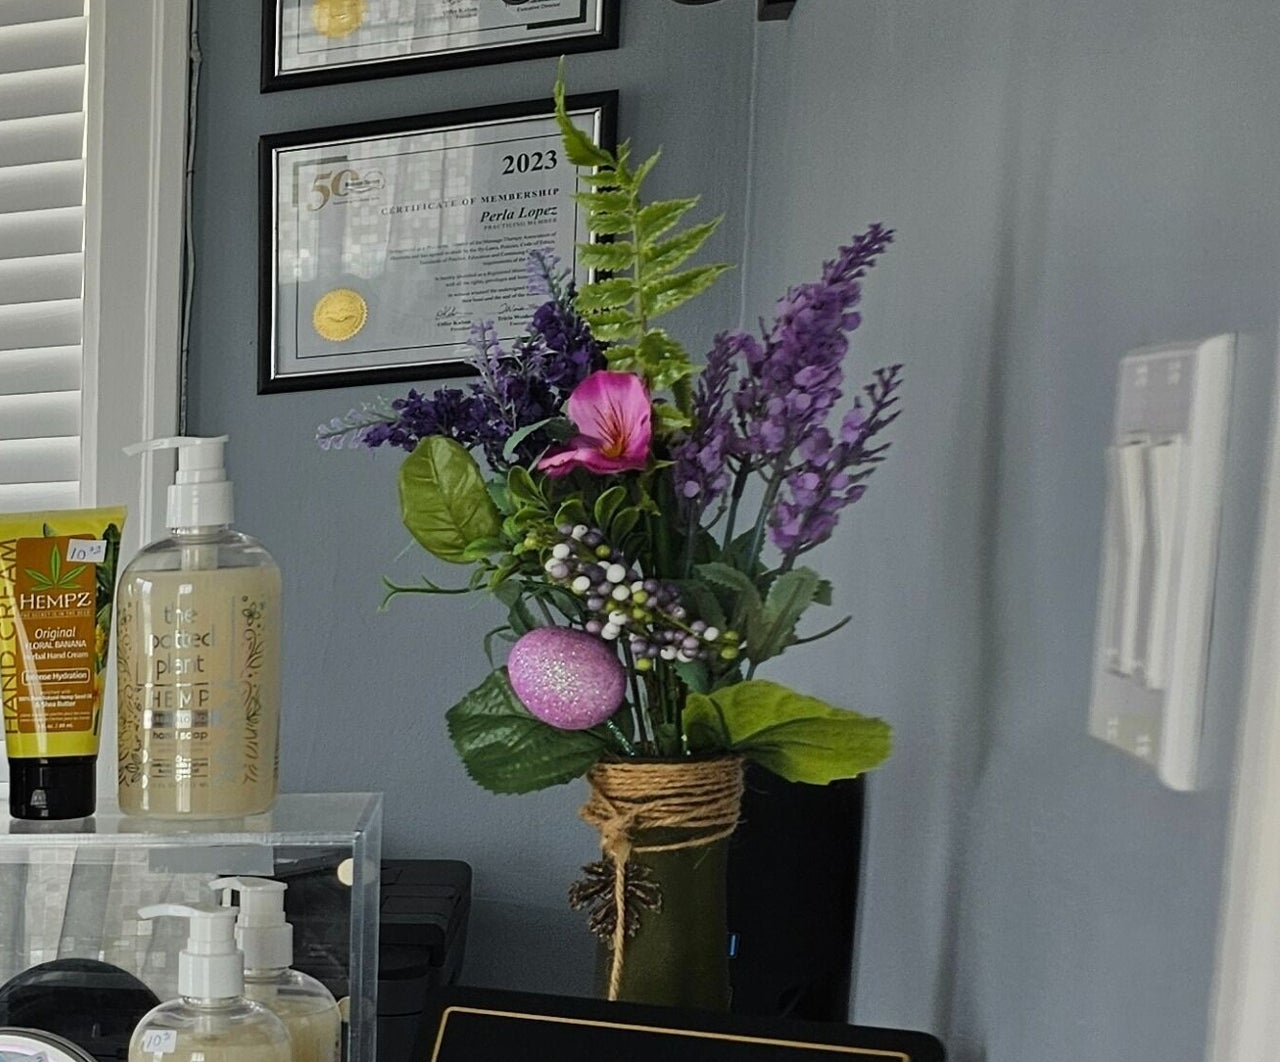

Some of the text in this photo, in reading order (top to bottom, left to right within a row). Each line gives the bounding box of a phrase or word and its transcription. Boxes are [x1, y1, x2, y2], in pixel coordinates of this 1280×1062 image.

[502, 149, 558, 176] 2023
[381, 199, 458, 216] CERTIFICATE
[461, 197, 475, 206] OF
[481, 187, 560, 204] MEMBERSHIP
[480, 206, 558, 224] Perla Lopez
[20, 592, 92, 610] HEMPZ
[165, 602, 198, 625] the
[34, 626, 76, 640] Original
[54, 640, 87, 649] BANANA
[46, 652, 66, 660] Hand
[66, 650, 89, 659] Cream
[157, 653, 205, 680] plant
[26, 671, 88, 681] ense Hydration
[0, 650, 18, 734] HAND
[151, 689, 209, 708] HEMP
